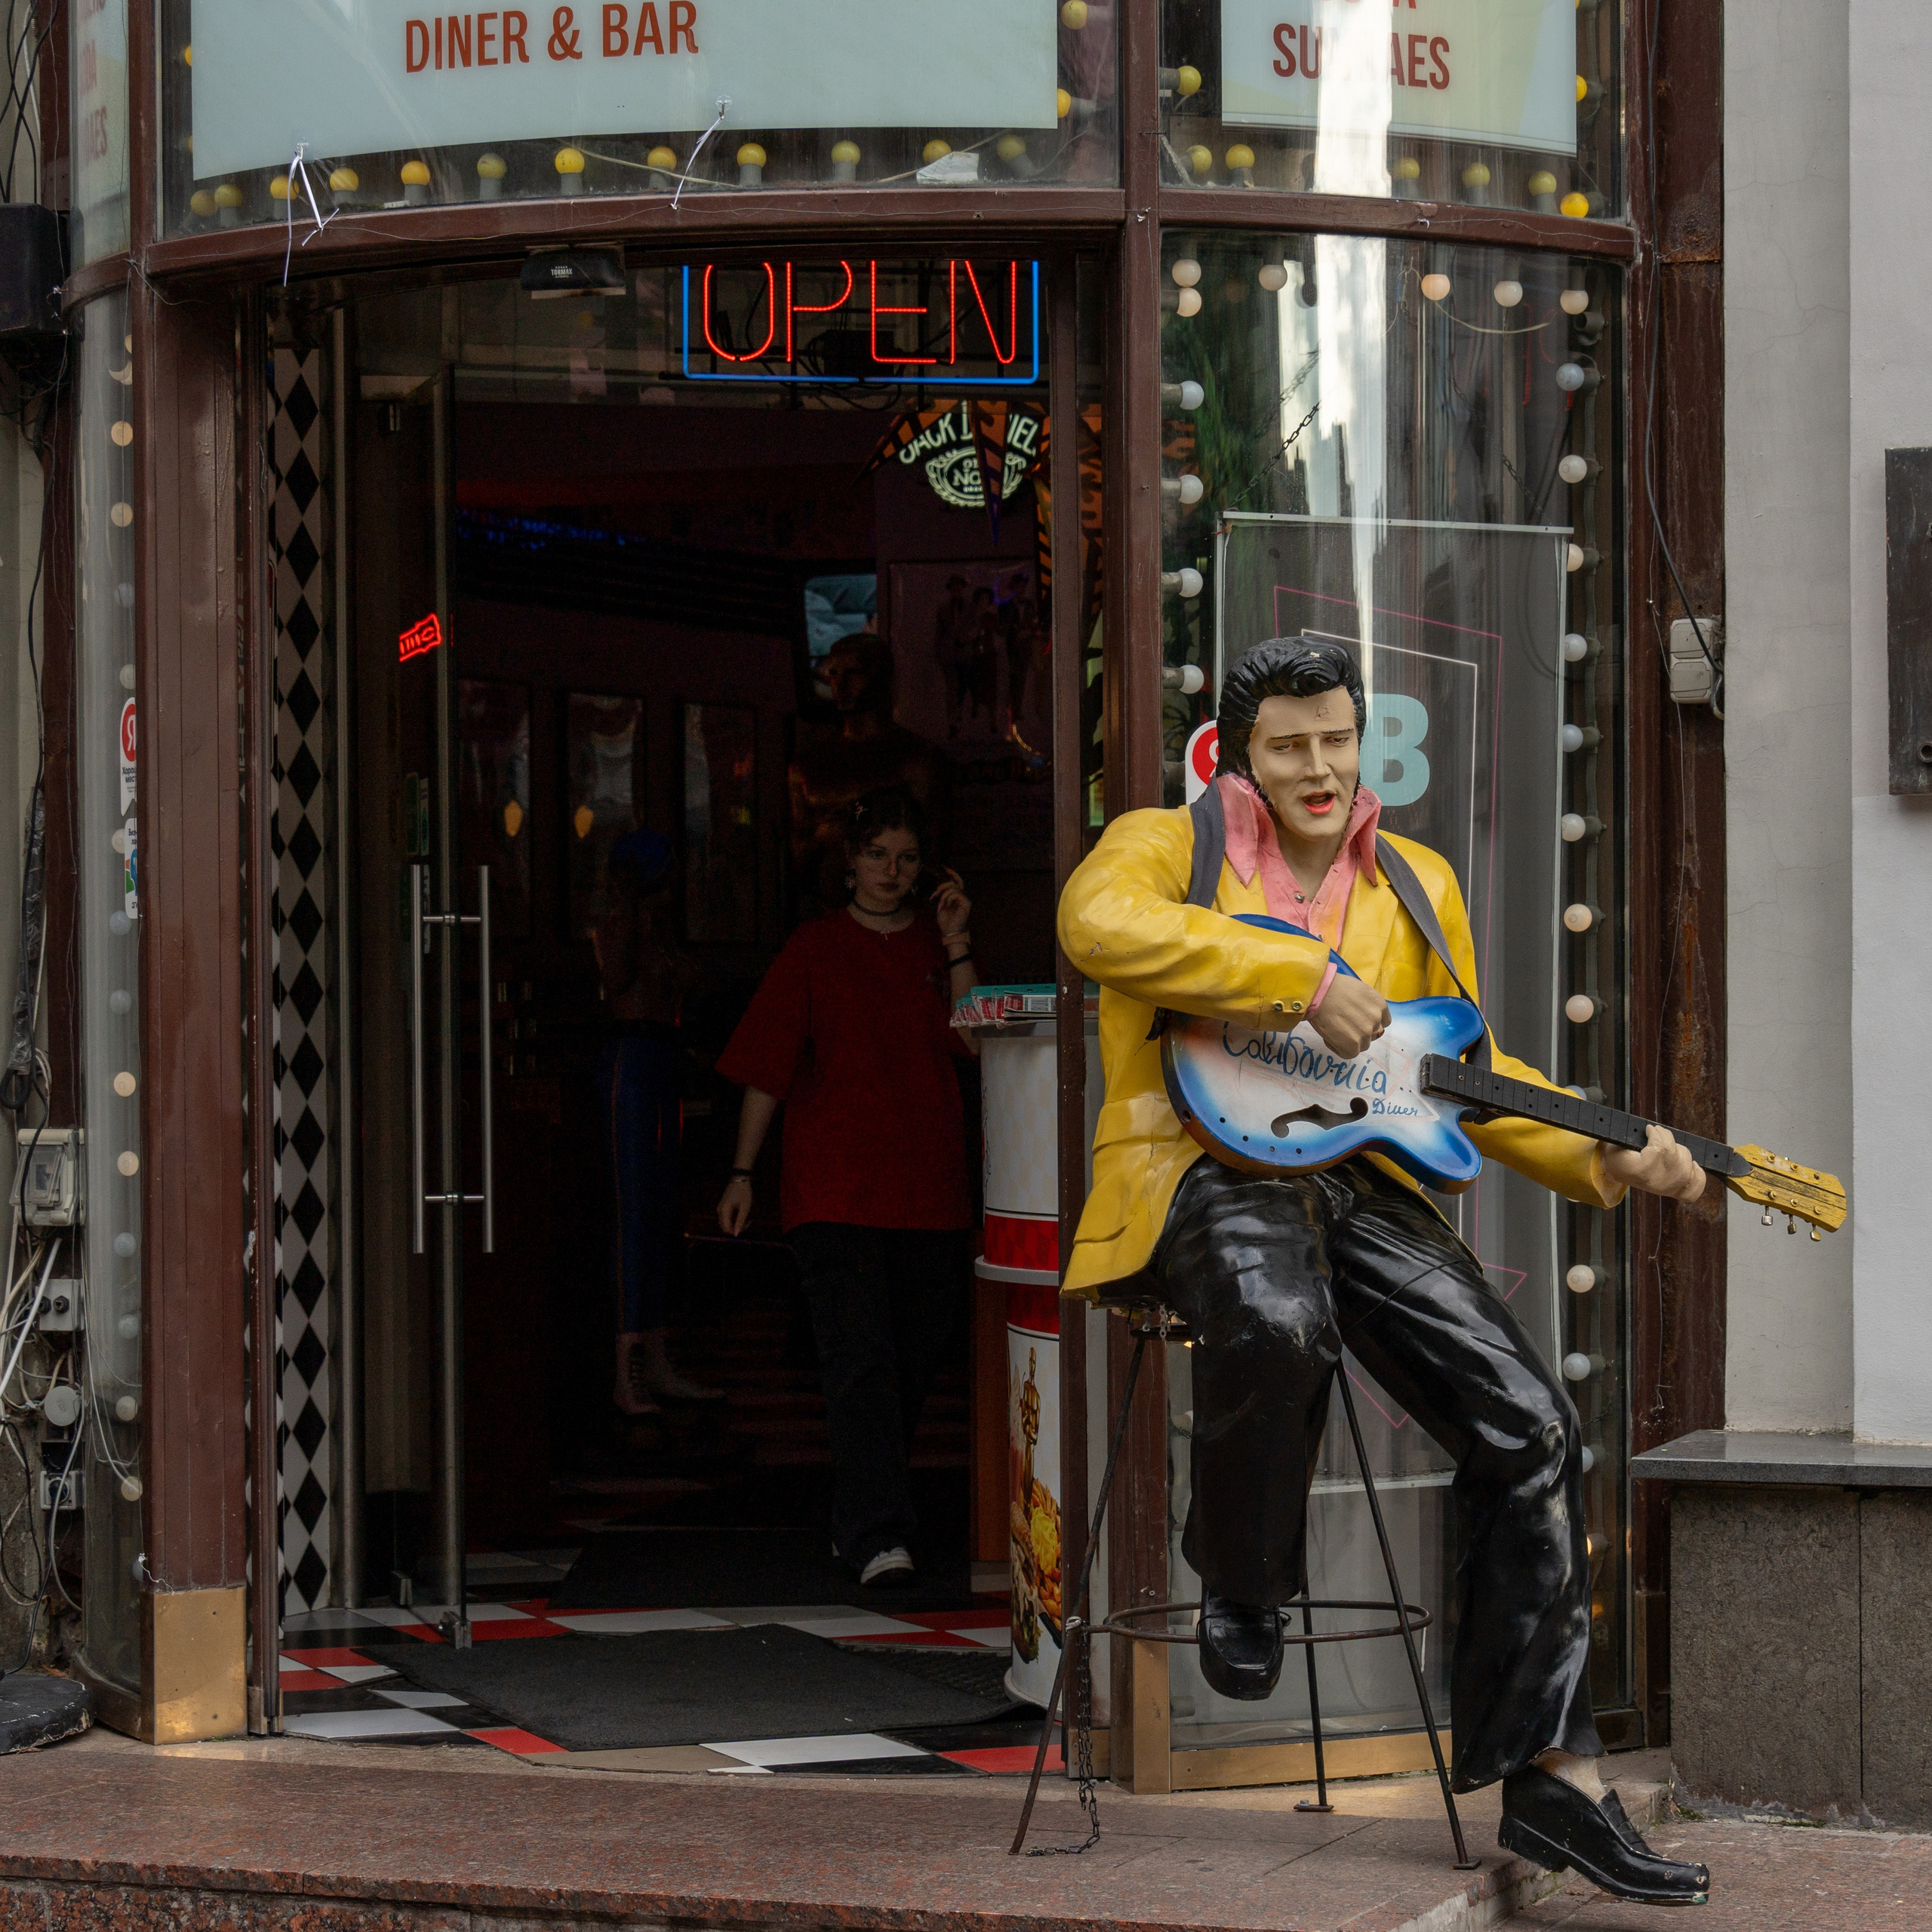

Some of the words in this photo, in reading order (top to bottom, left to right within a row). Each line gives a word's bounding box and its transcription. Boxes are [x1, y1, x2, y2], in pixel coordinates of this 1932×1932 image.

[406, 11, 530, 73] DINER
[547, 6, 583, 61] &
[603, 0, 699, 57] BAR
[1372, 1097, 1418, 1117] Diner
